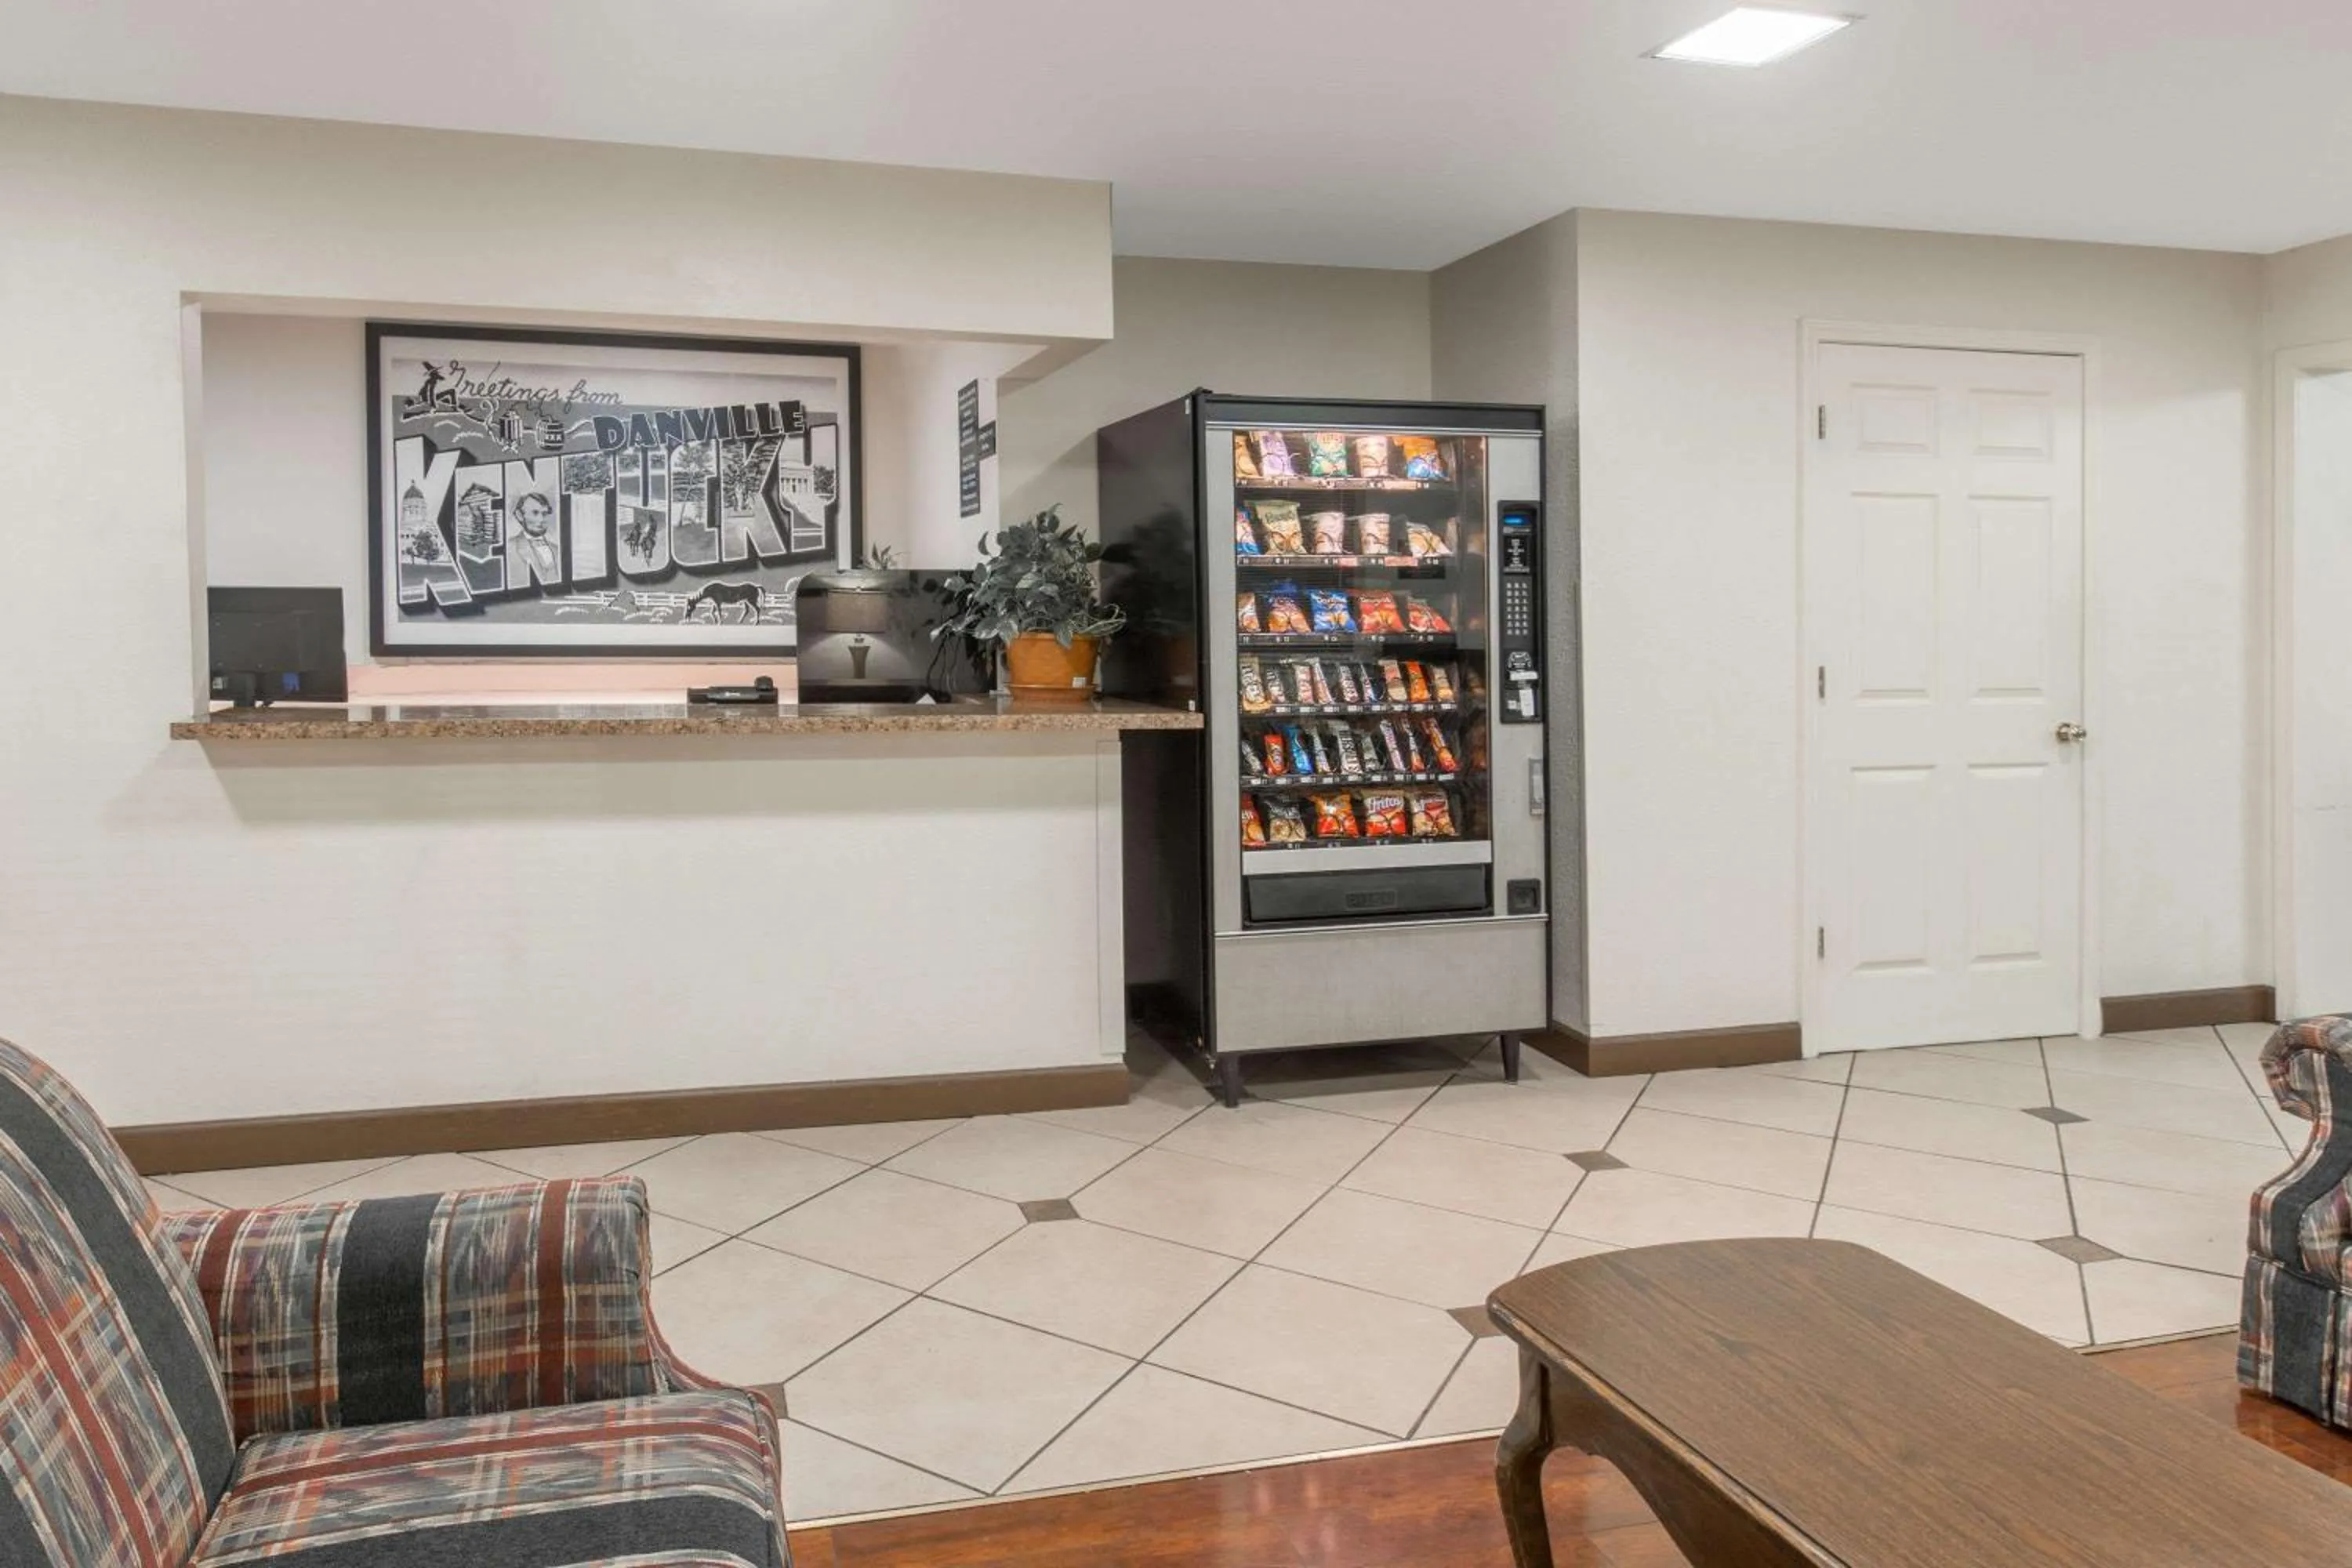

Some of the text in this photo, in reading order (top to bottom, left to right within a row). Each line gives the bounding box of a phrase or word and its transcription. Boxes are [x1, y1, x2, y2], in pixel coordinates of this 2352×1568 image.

[448, 359, 623, 414] Greetings from
[593, 401, 806, 452] DANVILLE
[394, 423, 839, 607] KENTUCKY
